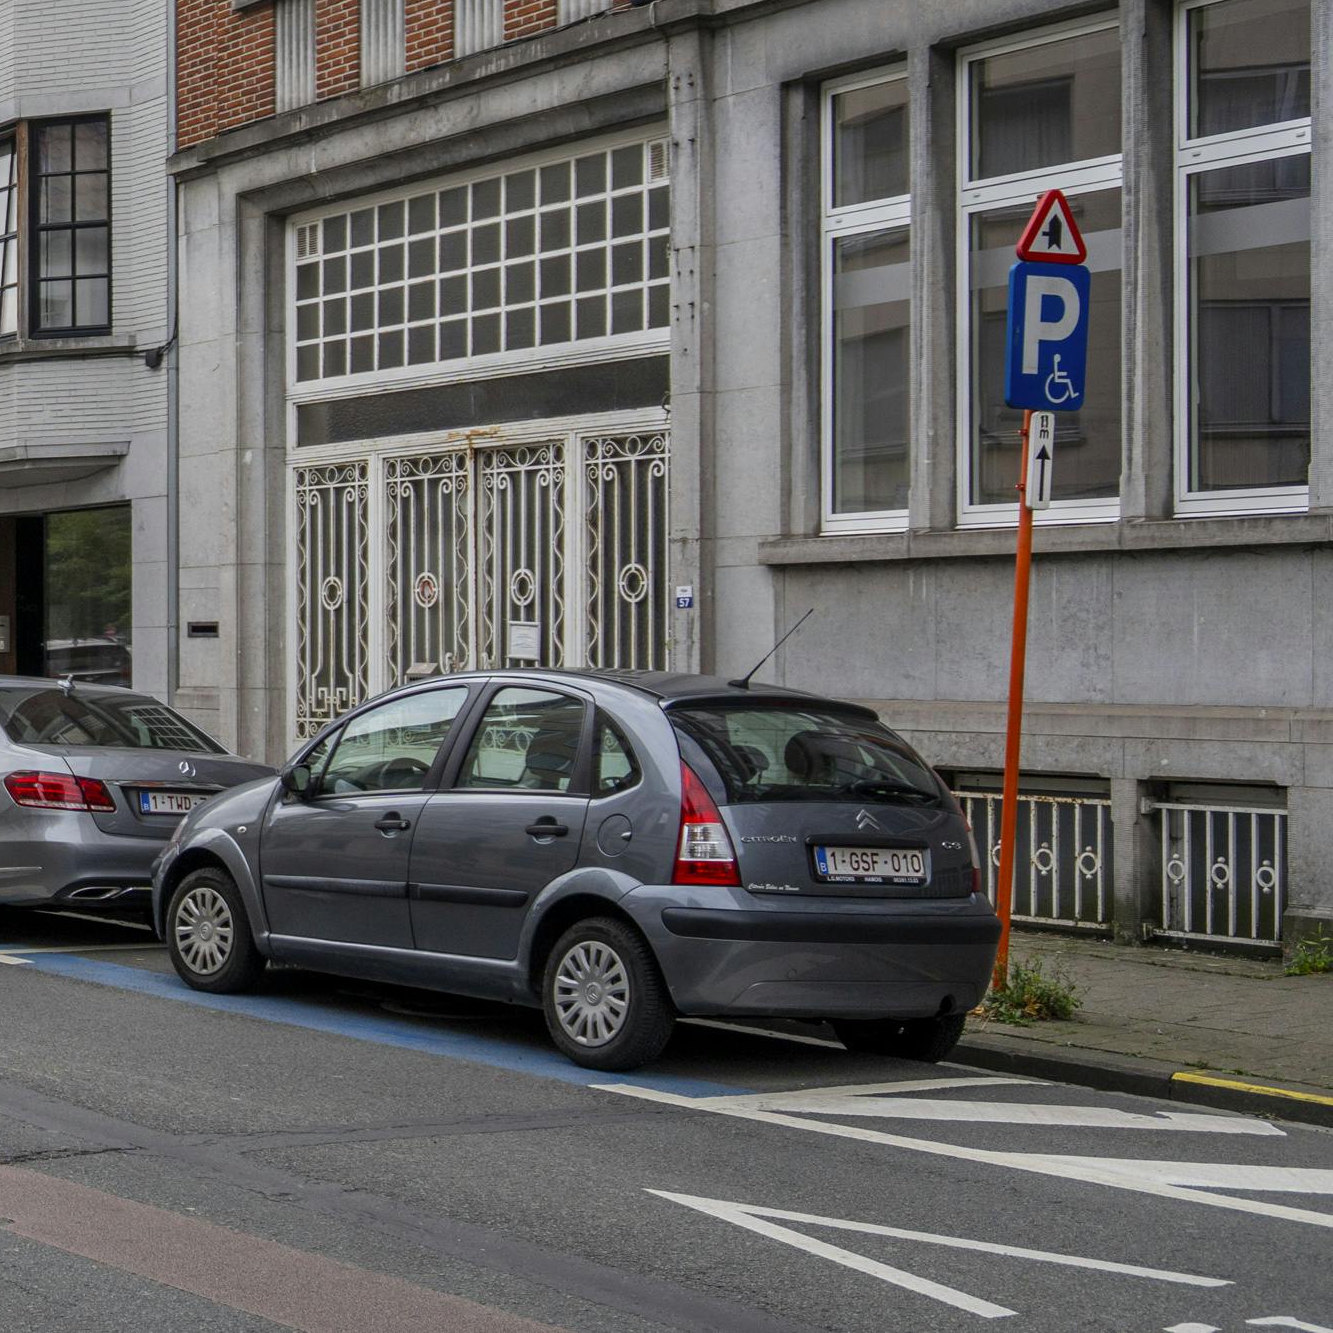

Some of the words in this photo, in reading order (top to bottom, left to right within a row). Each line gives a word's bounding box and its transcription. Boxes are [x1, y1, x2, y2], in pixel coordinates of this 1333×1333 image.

[1022, 275, 1080, 374] P
[1040, 429, 1049, 439] m
[678, 597, 690, 608] 57
[740, 834, 797, 843] CITROËN
[941, 840, 962, 851] C3
[819, 862, 827, 872] B
[830, 850, 922, 873] 1-GSF-010
